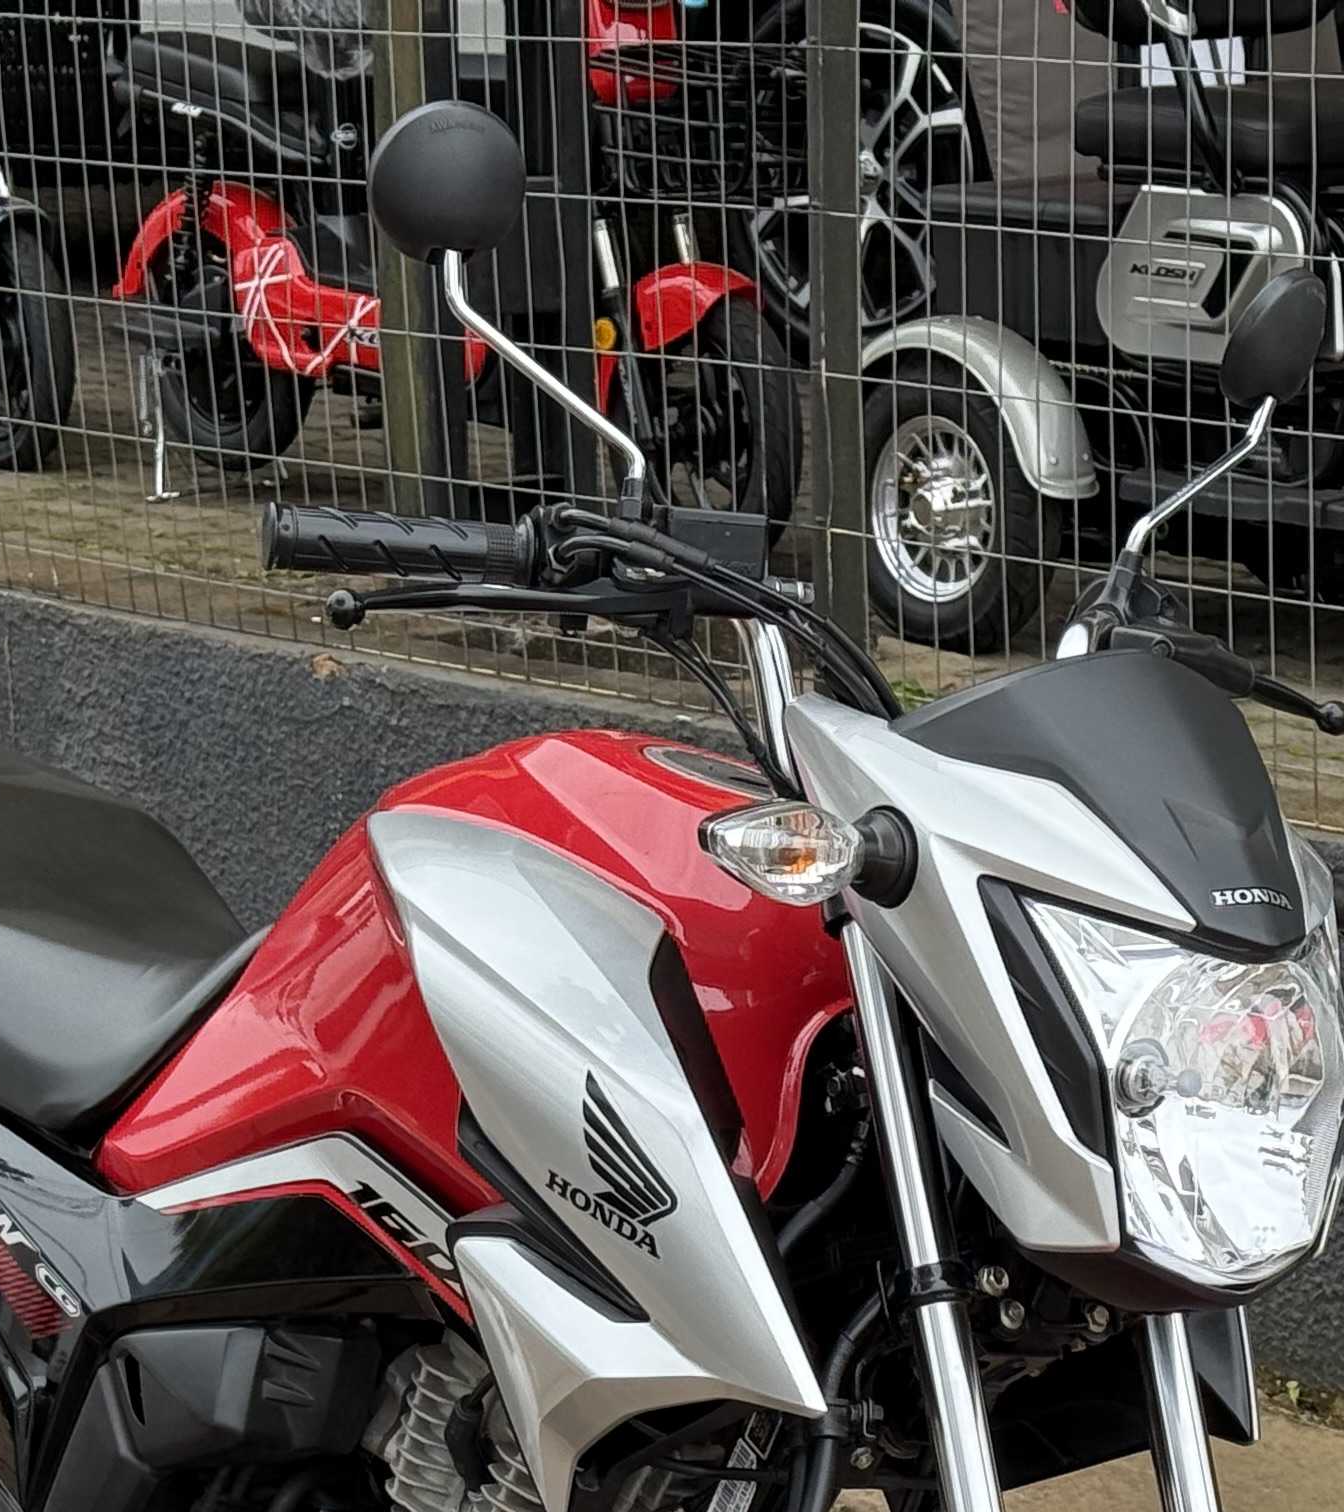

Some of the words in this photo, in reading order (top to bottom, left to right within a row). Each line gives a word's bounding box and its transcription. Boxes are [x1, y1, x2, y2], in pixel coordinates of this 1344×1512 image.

[1211, 888, 1294, 911] HONDA
[544, 1168, 662, 1260] HONDA
[35, 1263, 80, 1317] CG
